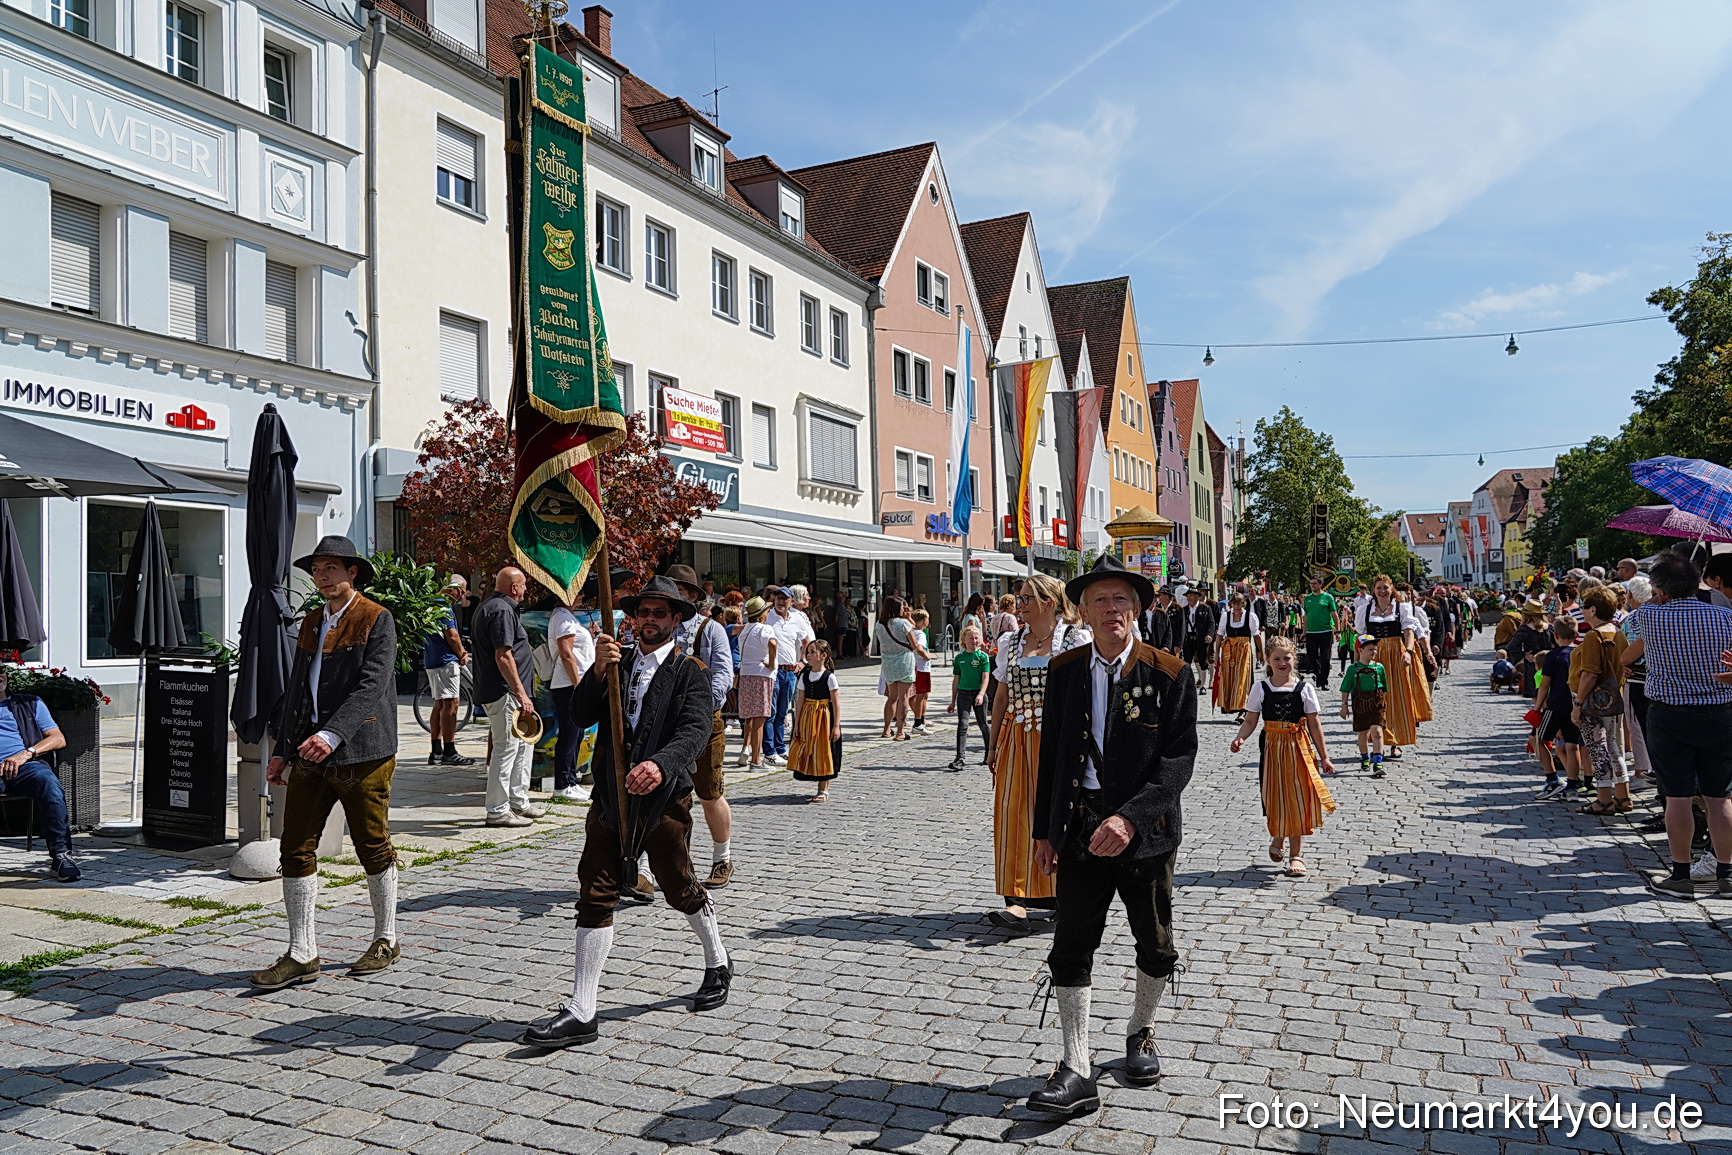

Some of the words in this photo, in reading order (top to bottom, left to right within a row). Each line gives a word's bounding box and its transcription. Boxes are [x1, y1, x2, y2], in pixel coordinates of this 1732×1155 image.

[2, 67, 77, 130] LEN
[85, 98, 213, 179] WEBER
[549, 141, 567, 159] Zur
[539, 284, 579, 303] gewidmet
[550, 301, 568, 312] vom
[538, 307, 580, 331] Paten
[539, 344, 585, 366] Wolfstein
[4, 378, 153, 422] IMMOBILIEN
[667, 393, 695, 410] Suche
[159, 680, 209, 692] Flammkuchen
[170, 697, 194, 706] Elsässer
[172, 708, 192, 716] Italiana
[161, 717, 172, 725] Drei
[173, 718, 188, 726] Käse
[188, 719, 202, 727] Hoch
[172, 728, 191, 737] Parma
[168, 738, 194, 748] Vegetaria
[169, 749, 193, 758] Salmone
[170, 769, 191, 778] Diavolo
[168, 779, 193, 789] Deliciosa
